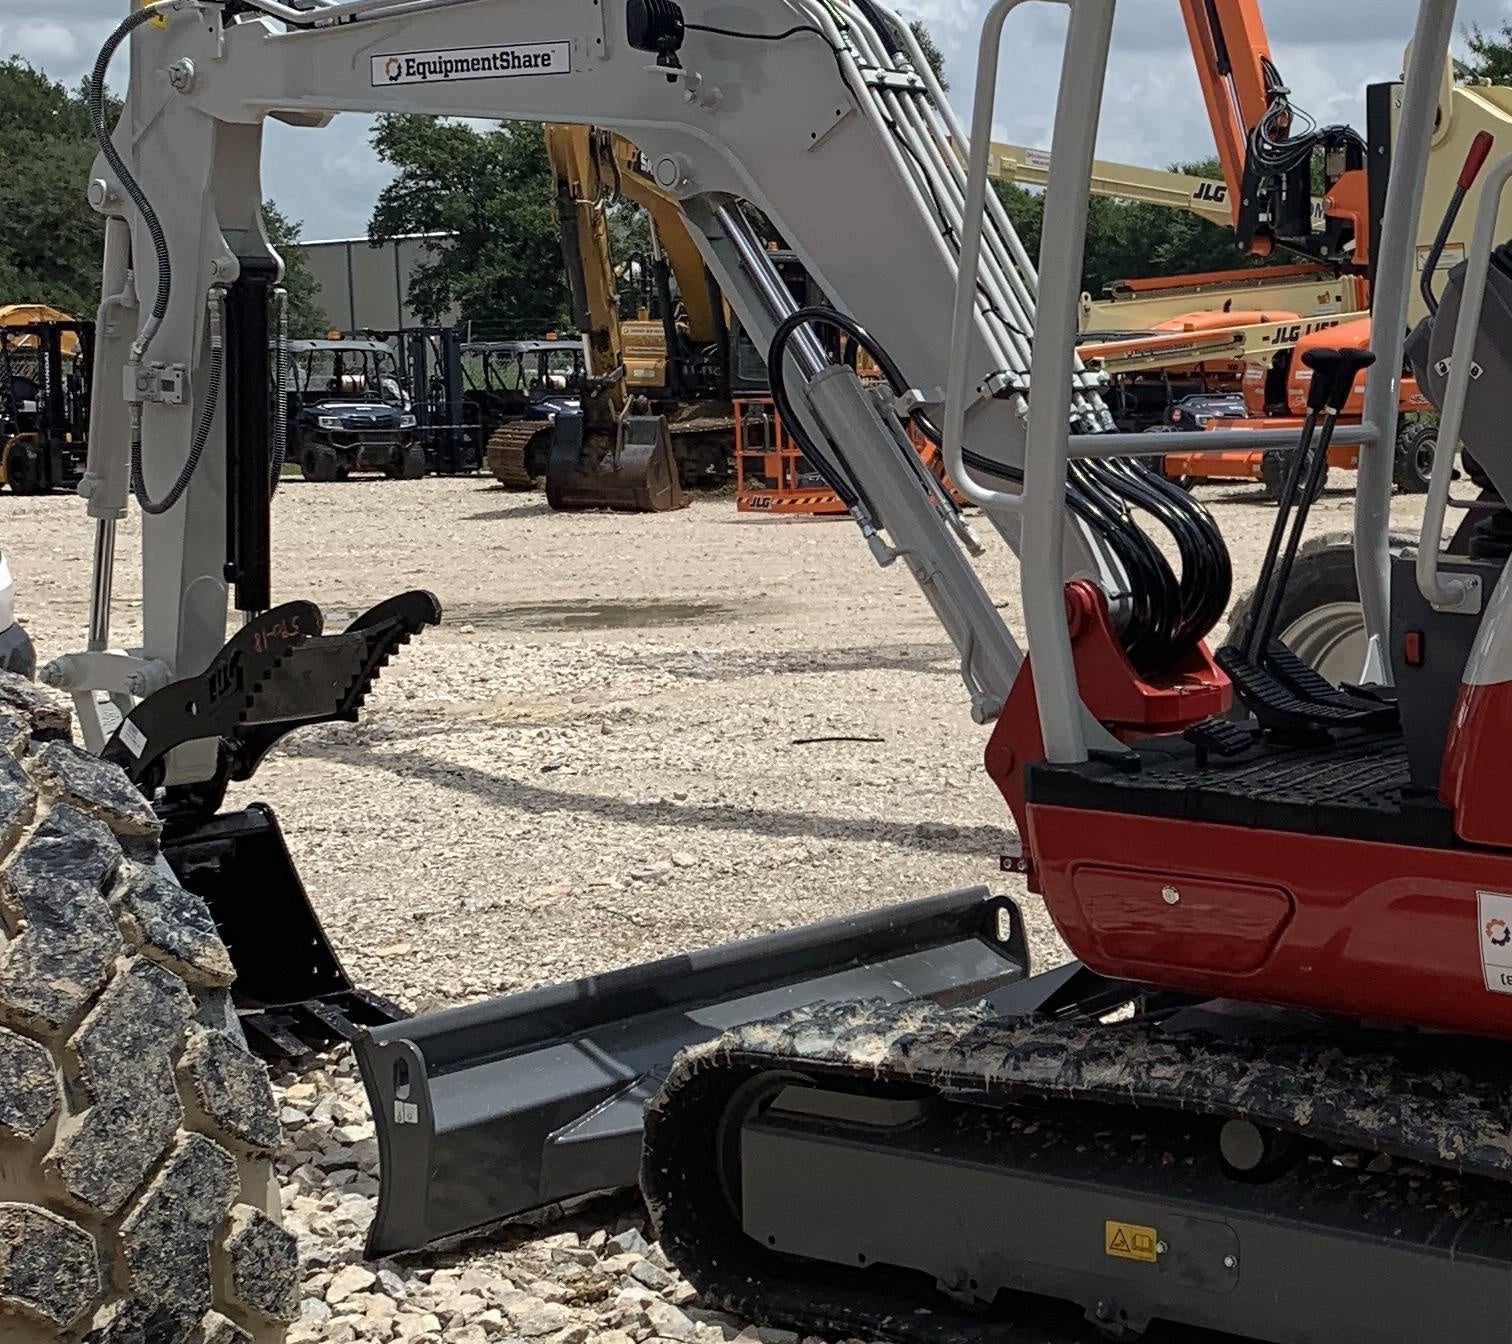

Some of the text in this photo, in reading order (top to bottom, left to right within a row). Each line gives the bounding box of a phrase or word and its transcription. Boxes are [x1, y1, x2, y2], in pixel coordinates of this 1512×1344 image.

[405, 50, 552, 80] EquipmentShare
[1193, 182, 1228, 203] JLG
[1271, 325, 1301, 345] JLG
[750, 496, 771, 508] JLG
